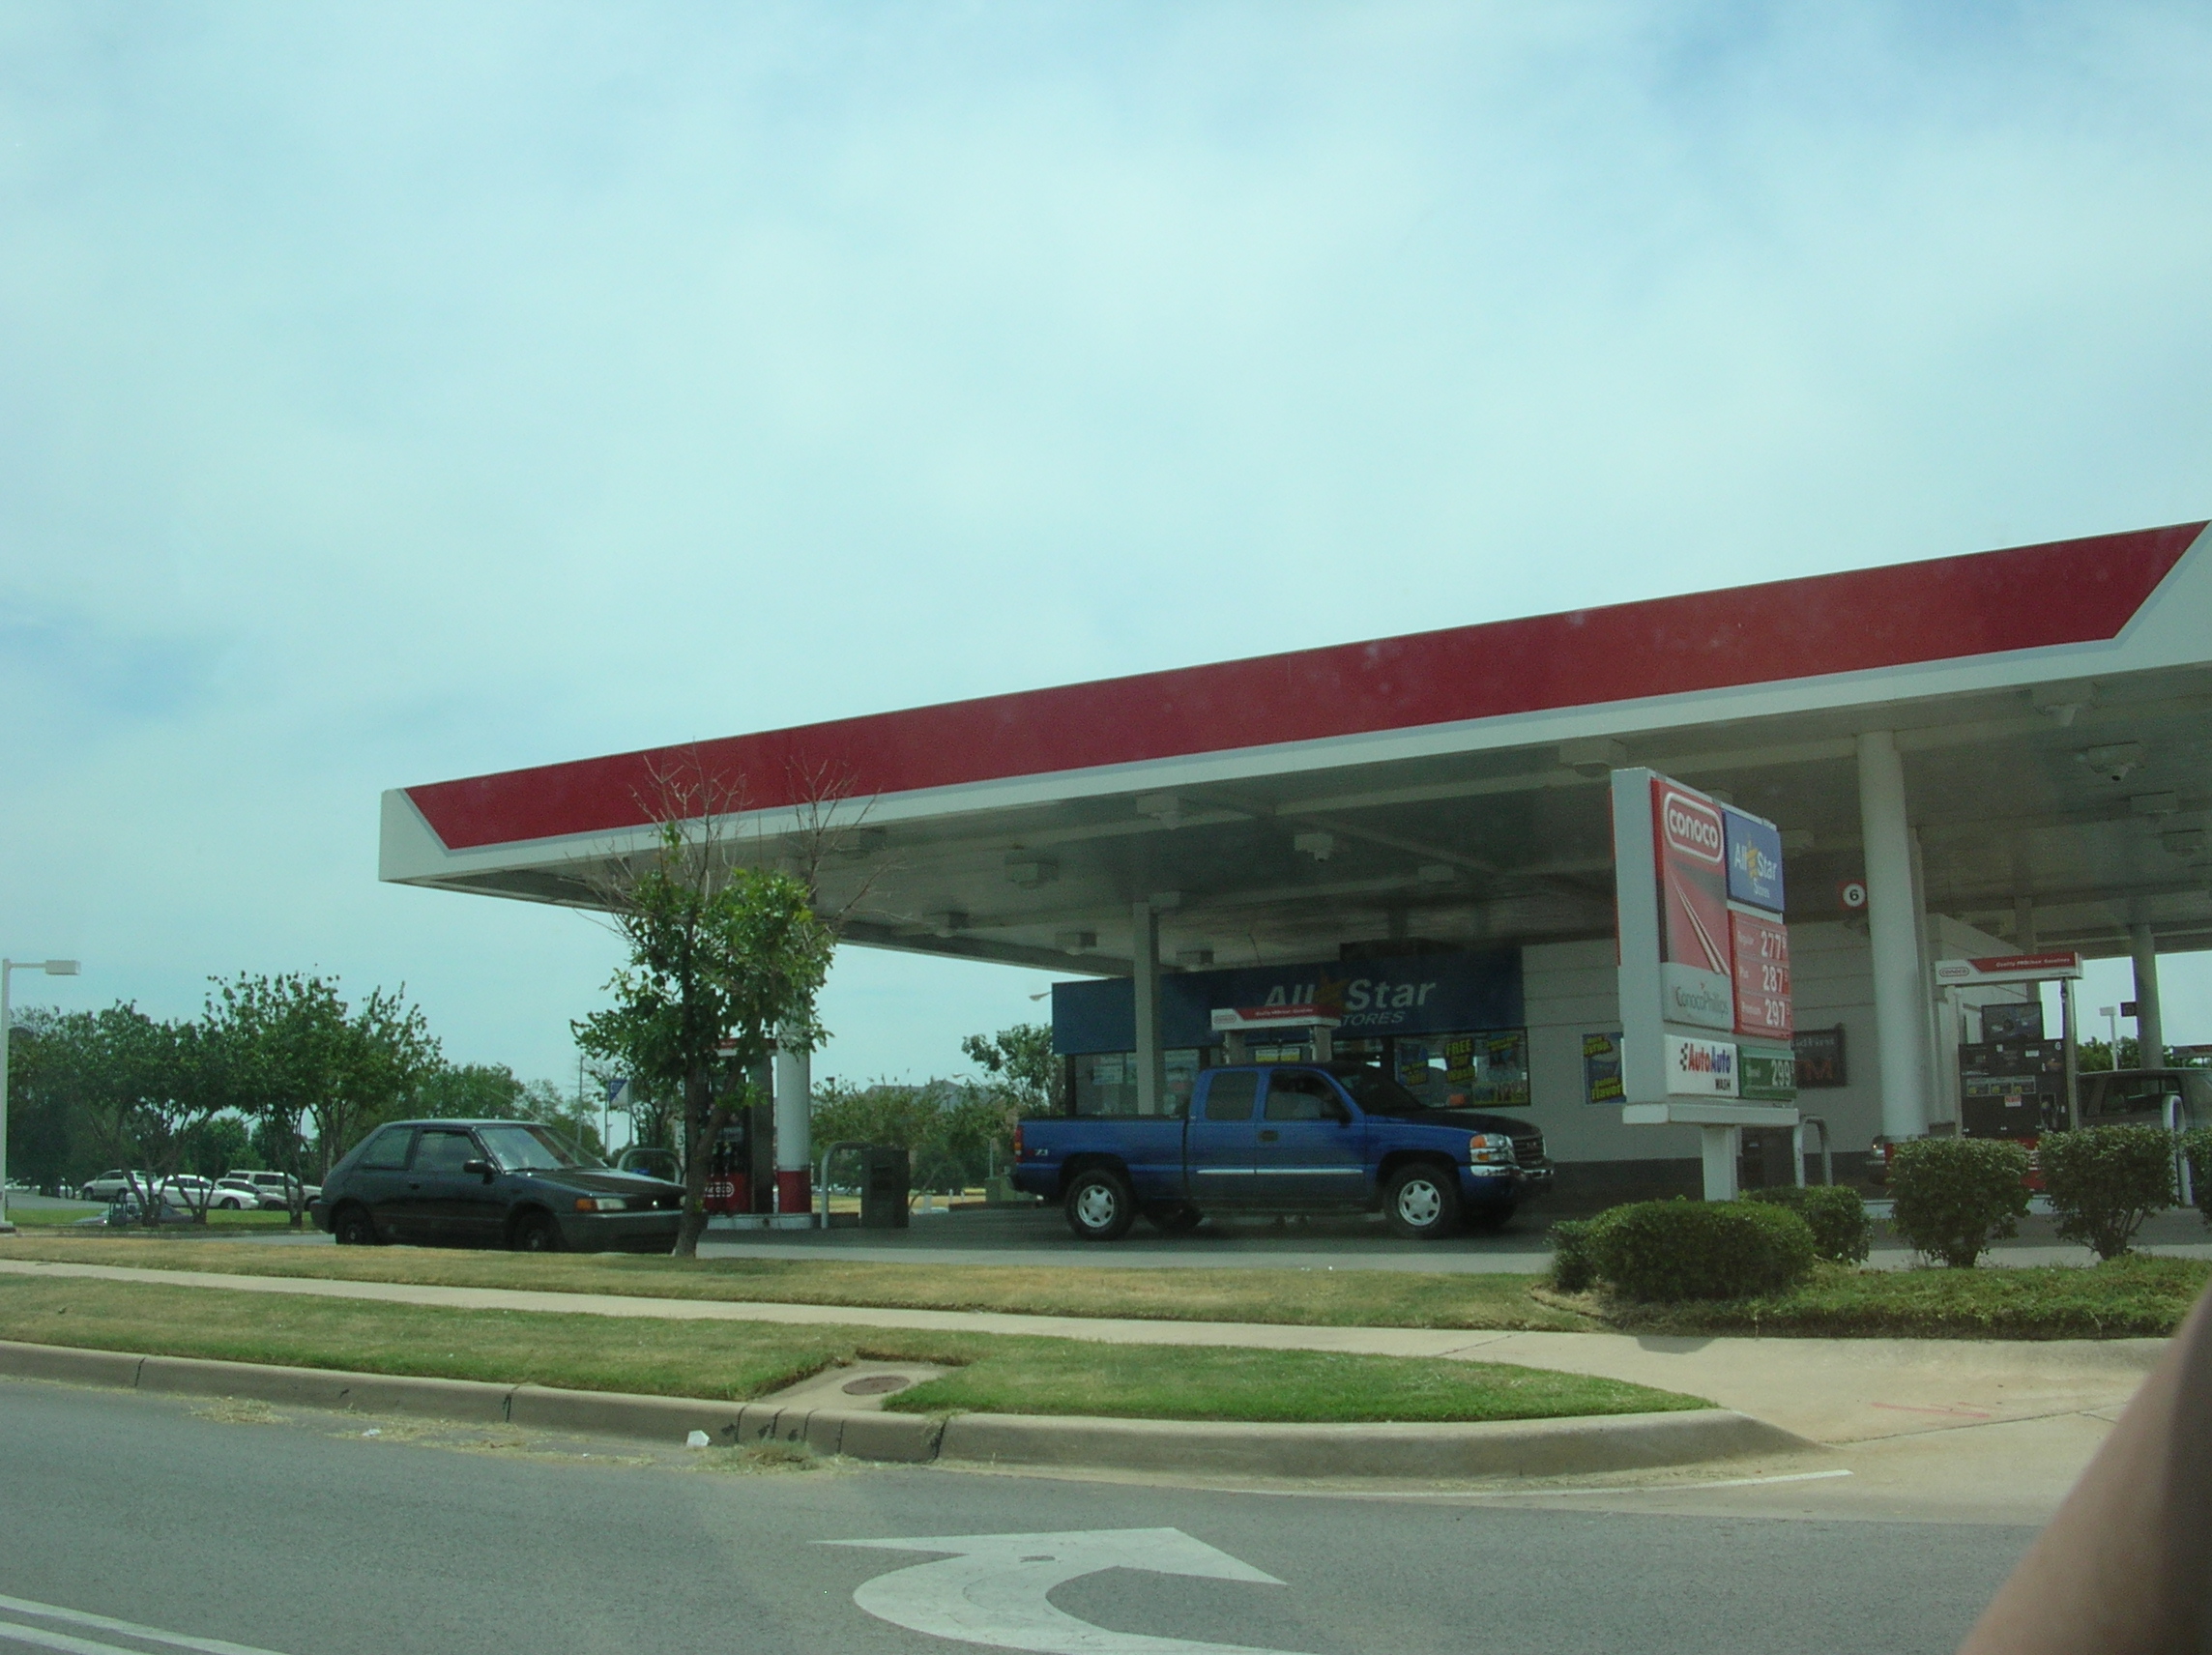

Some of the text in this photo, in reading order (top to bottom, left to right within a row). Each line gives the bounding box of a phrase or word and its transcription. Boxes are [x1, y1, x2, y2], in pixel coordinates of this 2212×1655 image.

[1670, 808, 1718, 849] conoco
[1734, 841, 1779, 882] All Star
[1849, 888, 1860, 902] 6
[1265, 978, 1437, 1010] All Star
[1340, 1010, 1406, 1028] TORES
[1445, 1038, 1473, 1057] FREE
